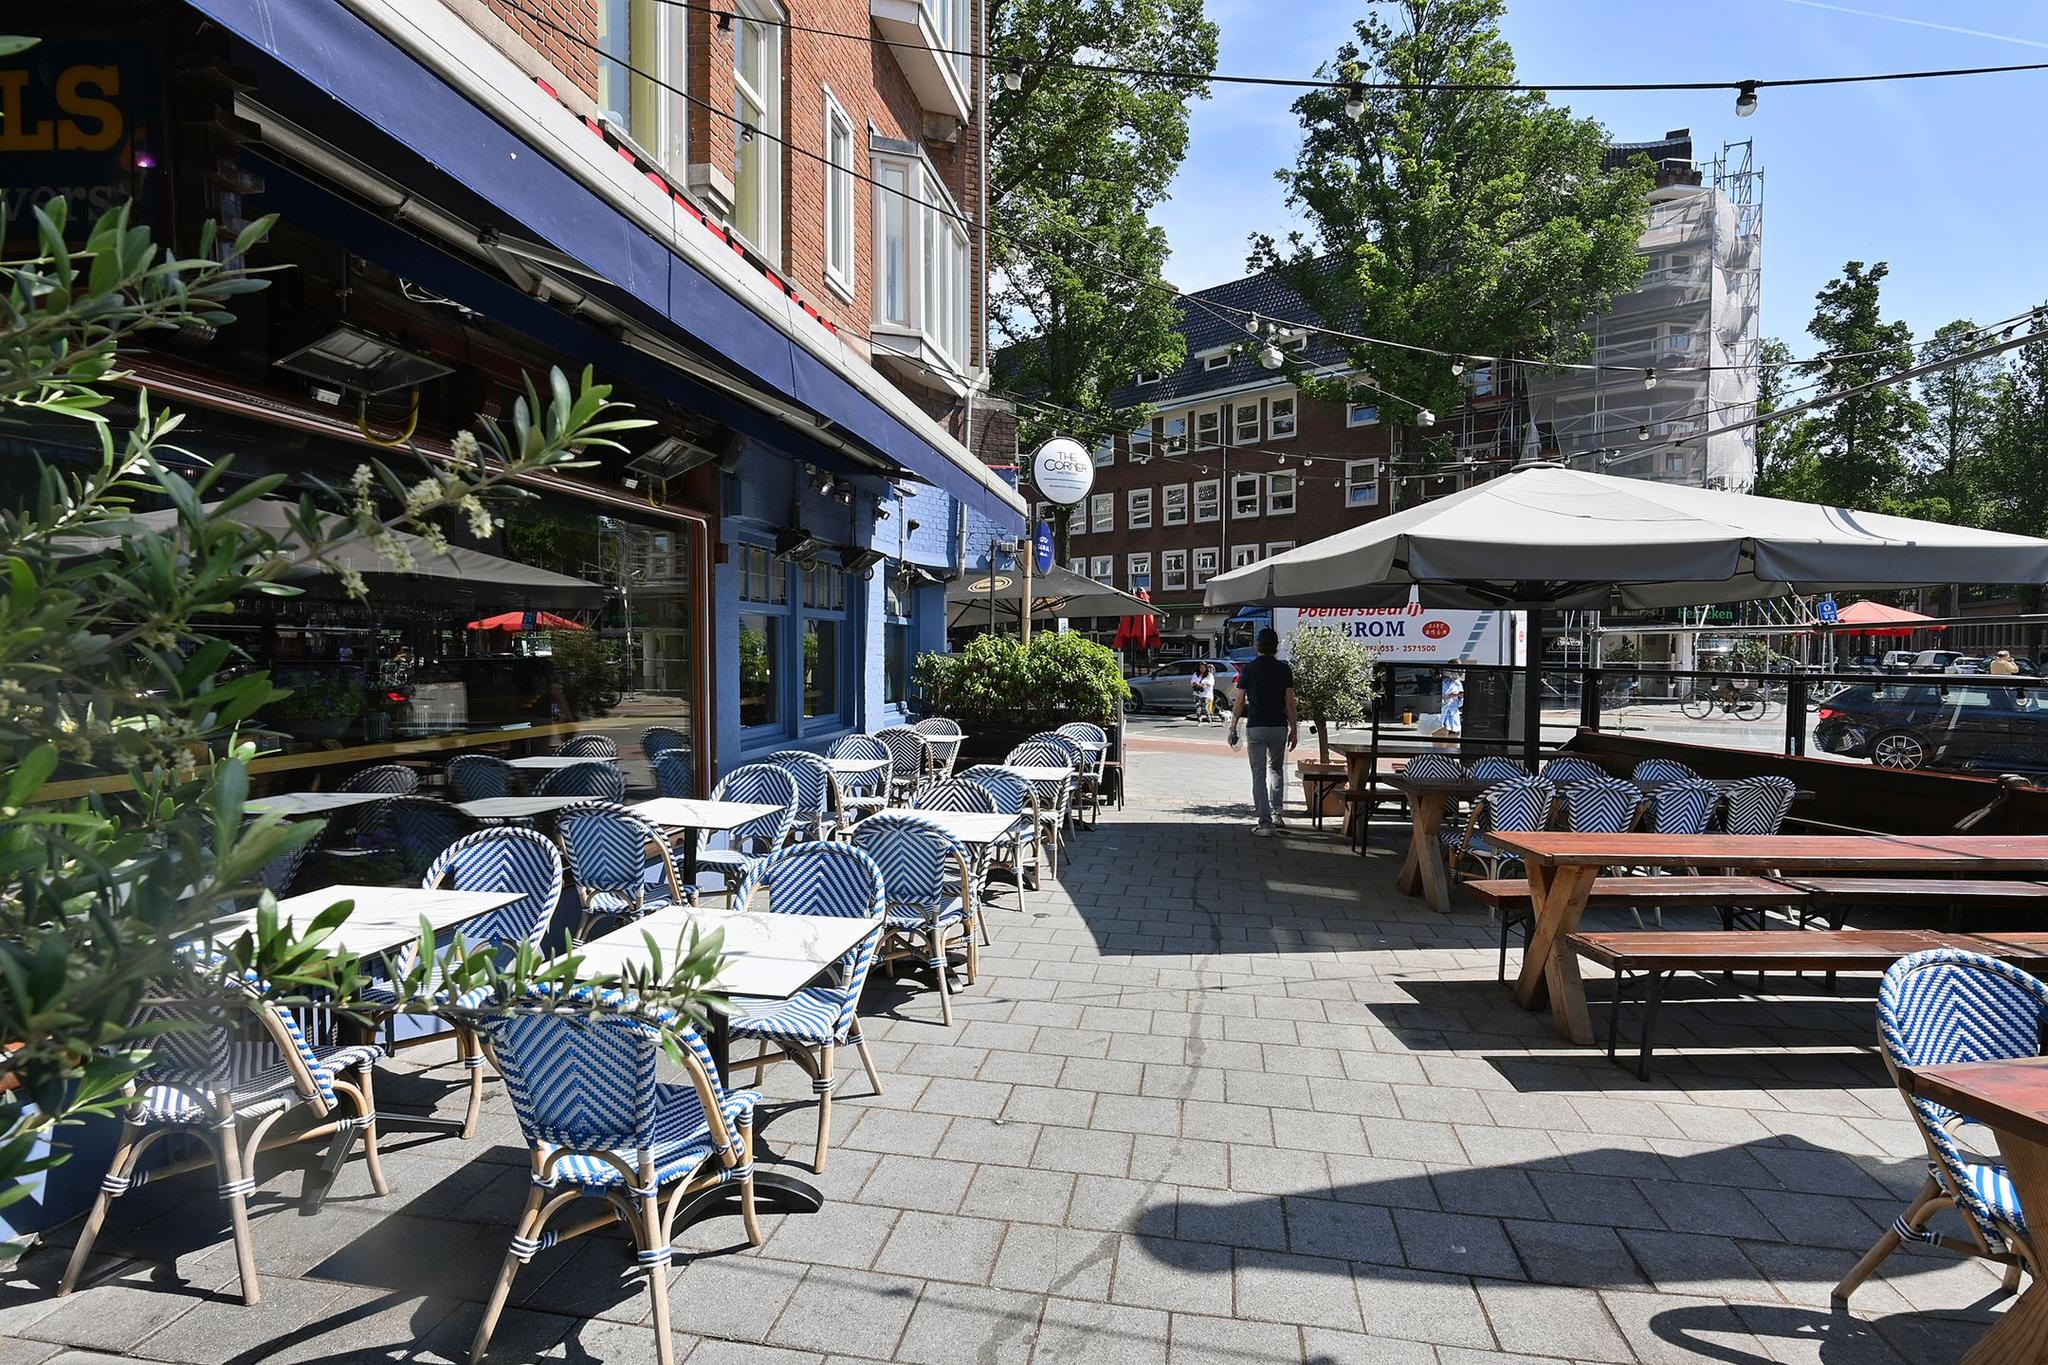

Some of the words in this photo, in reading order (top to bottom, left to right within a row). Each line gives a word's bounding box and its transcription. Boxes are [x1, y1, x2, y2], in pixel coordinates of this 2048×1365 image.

[1056, 451, 1077, 462] THE
[1043, 458, 1088, 473] CORNER
[1403, 644, 1437, 652] 2571500
